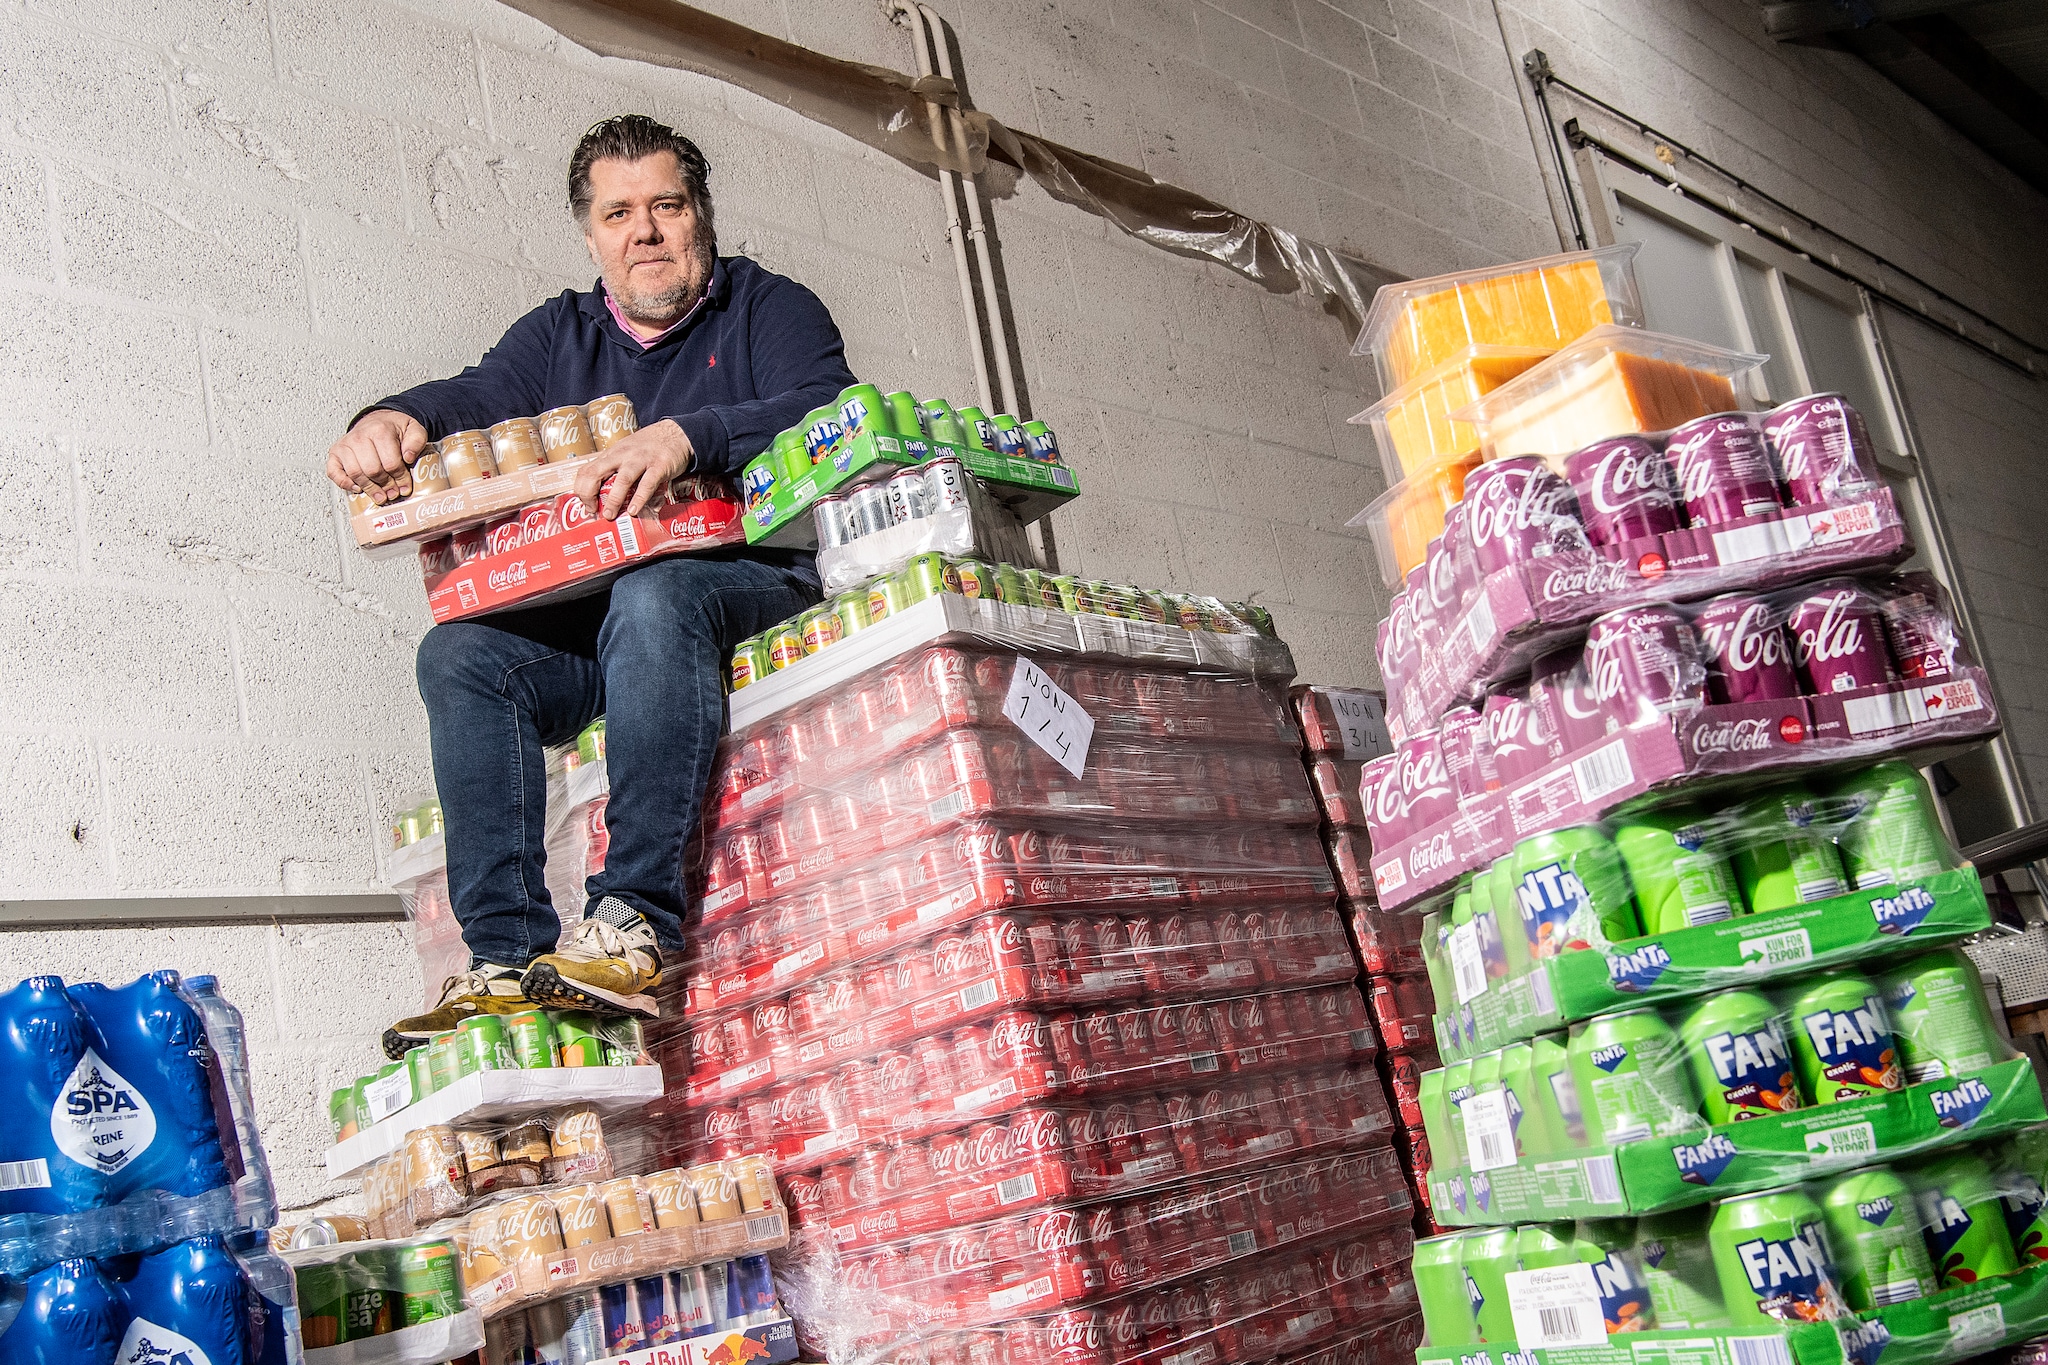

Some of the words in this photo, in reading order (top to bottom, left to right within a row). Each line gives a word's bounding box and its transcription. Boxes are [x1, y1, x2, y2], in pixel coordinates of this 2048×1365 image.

[507, 423, 523, 432] Coke
[1718, 422, 1748, 434] Coke
[451, 437, 467, 446] Coke
[904, 438, 929, 452] FANTA
[833, 447, 854, 468] FANTA
[393, 512, 403, 520] FOR
[416, 493, 465, 522] Coca-Cola
[754, 502, 776, 522] FANTA
[1833, 509, 1851, 524] NUR
[386, 517, 404, 528] EXPORT
[670, 515, 707, 537] Coca-Cola
[1836, 517, 1876, 536] EXPORT
[1668, 553, 1710, 567] FLAVOURS
[488, 560, 527, 589] Coca-Cola
[1543, 558, 1631, 601] Coca-Cola
[1703, 604, 1738, 620] Cherry
[1627, 614, 1661, 635] Coke
[774, 648, 799, 660] Lipon
[732, 666, 750, 679] ipton
[1025, 666, 1067, 715] NON
[1942, 684, 1958, 699] NUR
[1339, 698, 1375, 720] NON
[1946, 692, 1977, 711] EXPORT
[1019, 696, 1072, 760] 1/4
[1693, 716, 1772, 756] Coca-Cola
[799, 846, 835, 872] Coca-Cola
[1409, 831, 1455, 879] Coca-Cola
[1031, 876, 1068, 895] Coca-Cola
[1871, 887, 1935, 921] FANTA
[857, 921, 889, 945] Coca-Cola
[1765, 938, 1784, 951] KUN
[1785, 934, 1804, 948] FOR
[1606, 943, 1672, 978] FANTA
[1768, 946, 1806, 964] EXPORT
[719, 973, 748, 994] Coca-Cola
[1591, 1043, 1628, 1065] FANTA
[1826, 1060, 1857, 1078] exotic
[1726, 1085, 1756, 1100] exotic
[1929, 1078, 1991, 1116] FANTA
[66, 1090, 140, 1116] SPA
[92, 1130, 124, 1146] REINE
[1830, 1130, 1848, 1144] KUN
[1851, 1127, 1868, 1141] FOR
[1672, 1135, 1737, 1170] FANTA
[610, 1183, 630, 1193] Coke
[1857, 1197, 1895, 1218] FANTA
[861, 1209, 898, 1235] Coca-Cola
[588, 1243, 635, 1272] Coca-Cola
[563, 1265, 577, 1275] EXPORT
[1109, 1256, 1148, 1281] Coca-Cola
[1760, 1294, 1791, 1310] exotic
[680, 1306, 702, 1323] Bull
[1064, 1352, 1096, 1364] ORIGINAL
